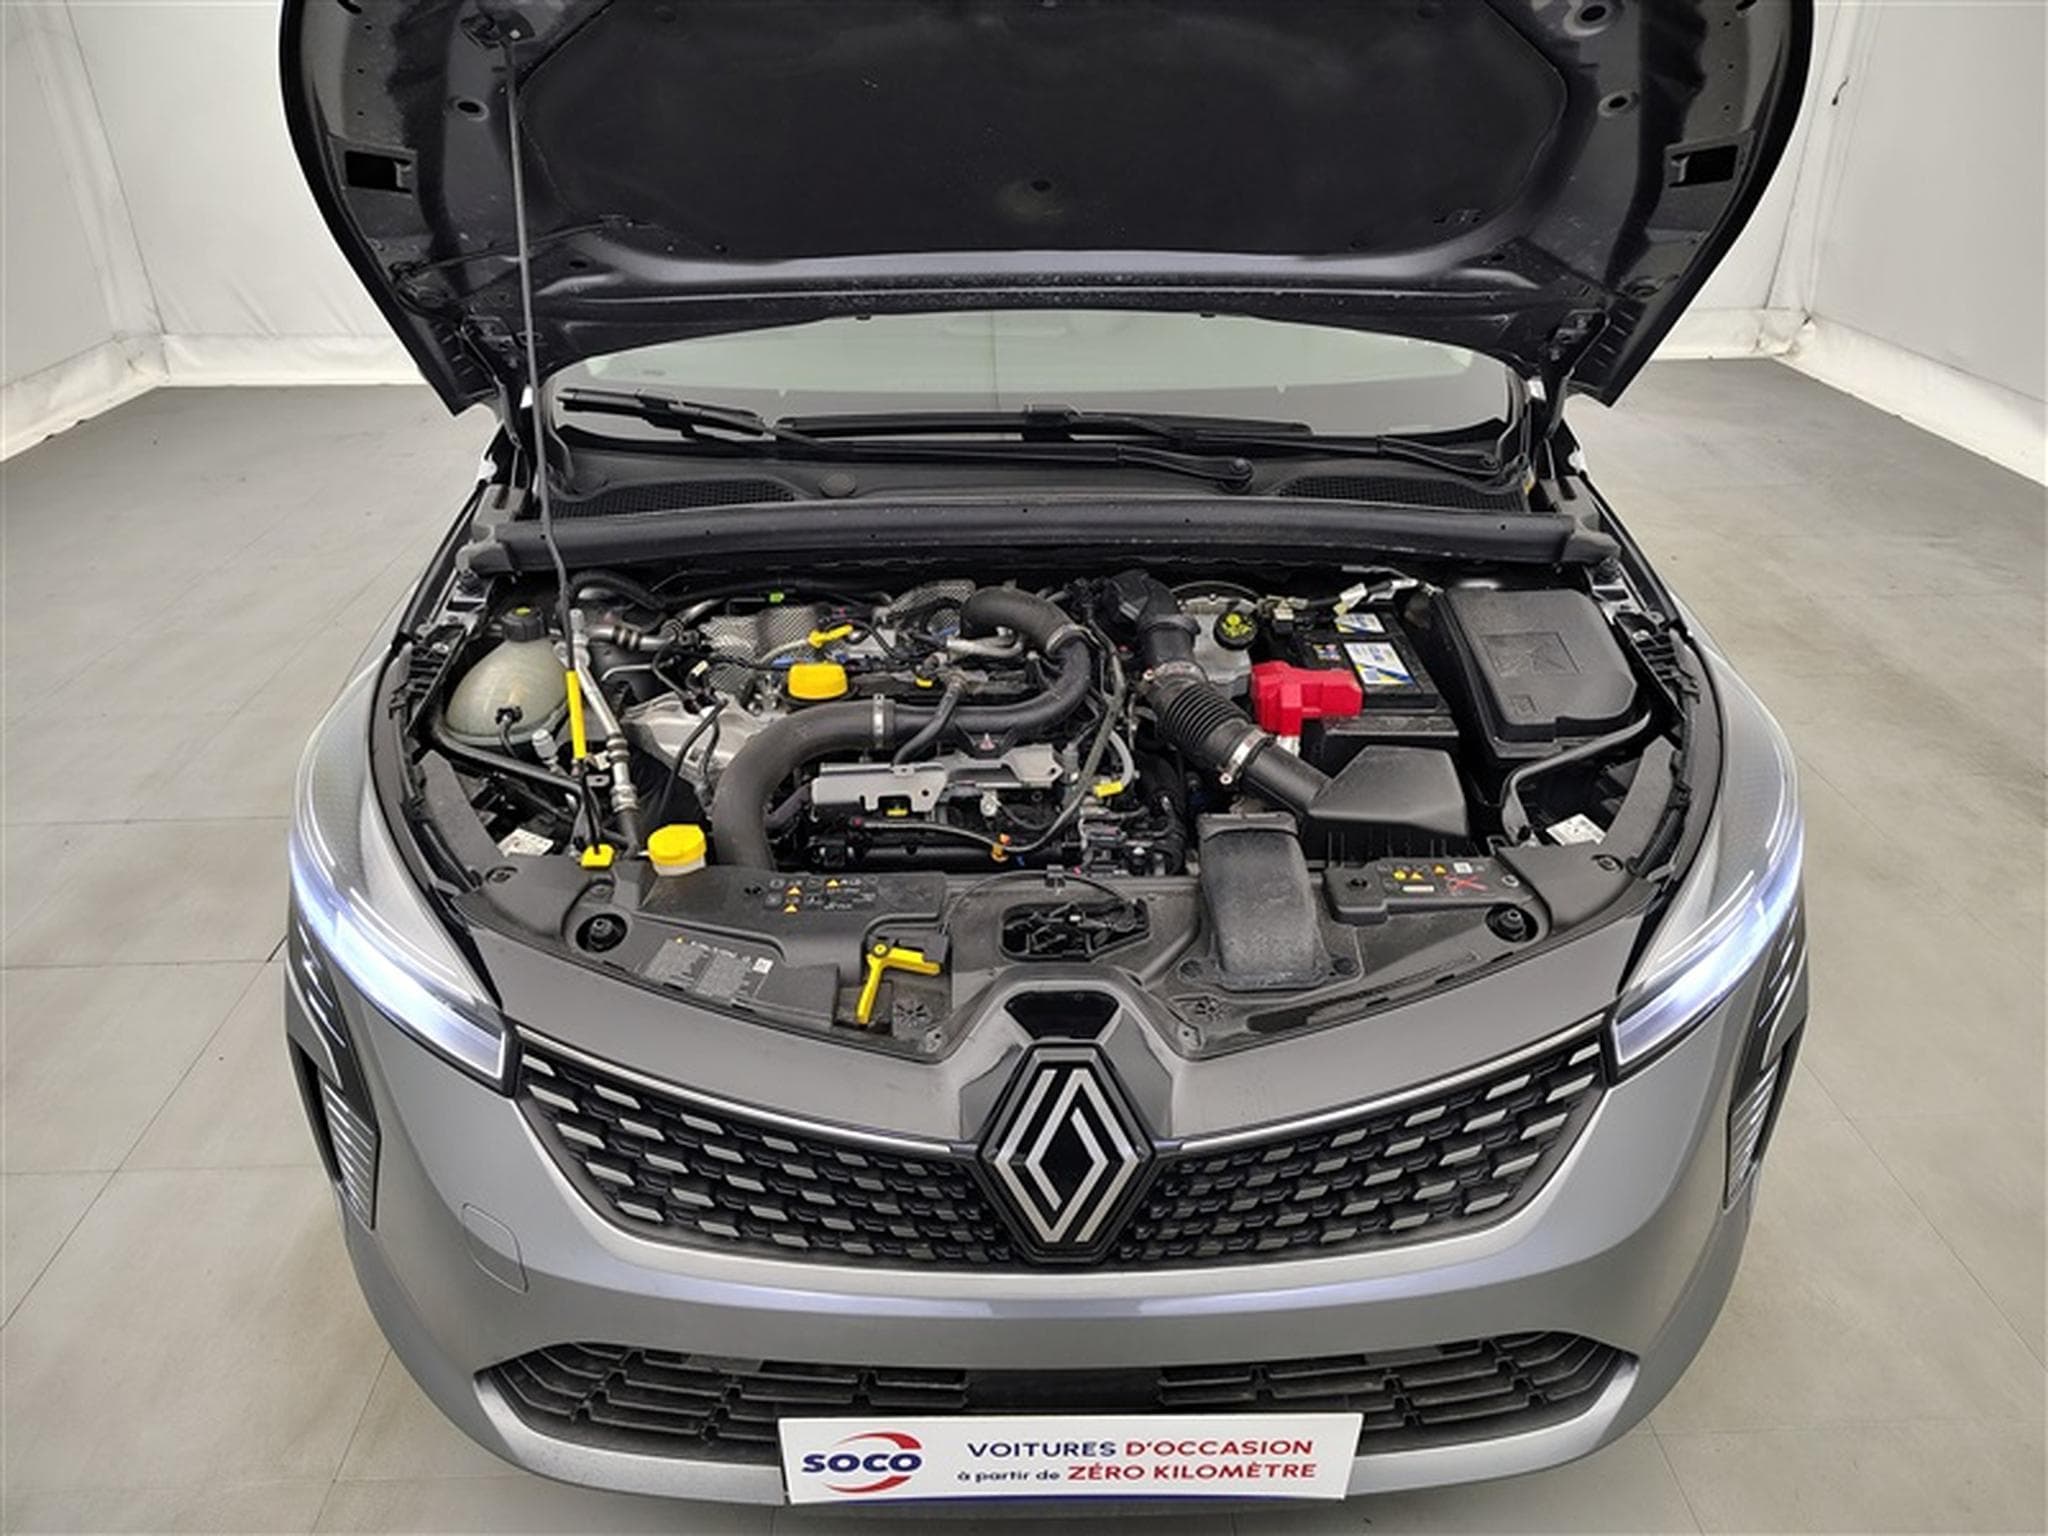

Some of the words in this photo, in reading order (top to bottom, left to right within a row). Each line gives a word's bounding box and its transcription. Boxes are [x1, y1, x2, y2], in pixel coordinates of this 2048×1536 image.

[967, 1441, 1117, 1458] VOITURES
[1125, 1440, 1313, 1457] D'OCCASION
[802, 1453, 922, 1473] SOCO
[976, 1469, 1030, 1484] partir
[1036, 1469, 1060, 1481] de
[1068, 1463, 1145, 1480] ZÉRO
[1154, 1462, 1317, 1479] KILOMÈTRE
